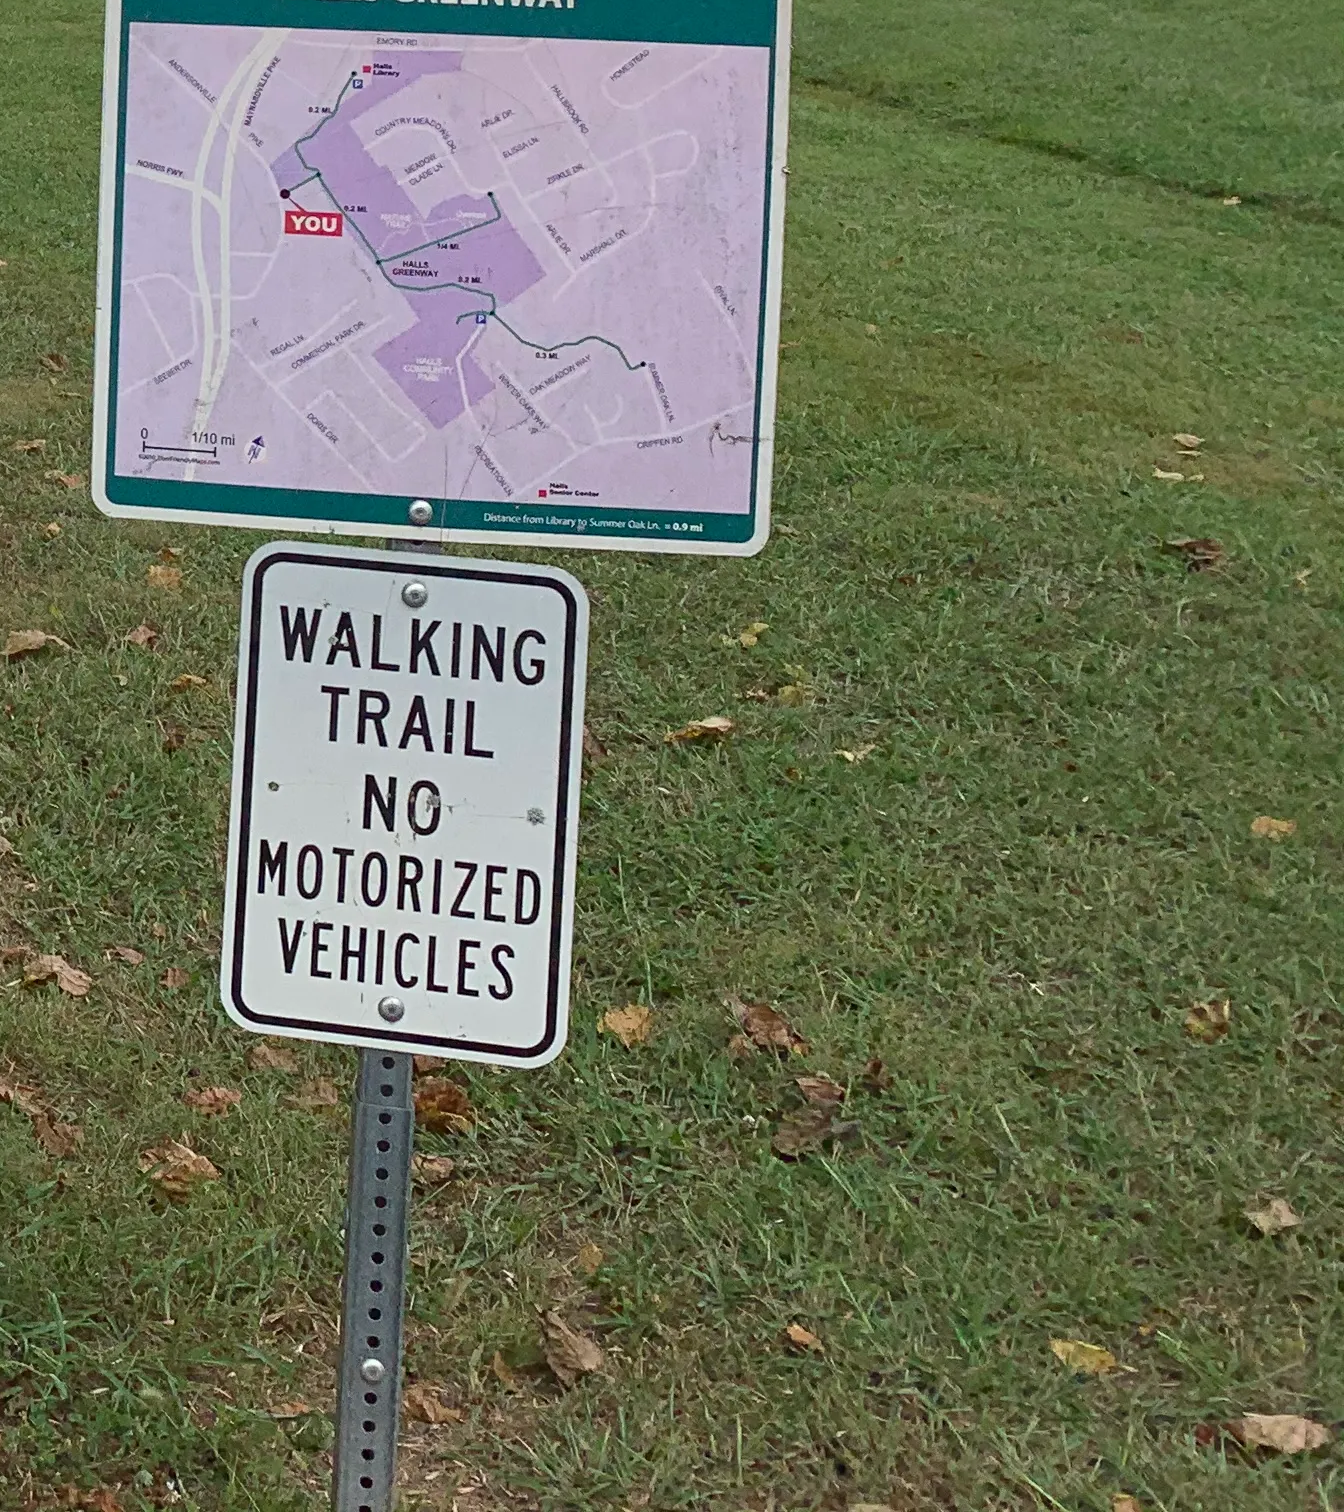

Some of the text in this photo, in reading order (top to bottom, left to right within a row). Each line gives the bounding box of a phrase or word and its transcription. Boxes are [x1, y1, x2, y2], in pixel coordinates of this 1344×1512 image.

[376, 37, 404, 46] EMORY
[610, 49, 650, 81] HOMESTEAD
[168, 59, 217, 104] ANDERSONVILLE
[244, 55, 281, 127] MAYNARDVILLE PIKE
[375, 117, 412, 136] COUNTRY
[136, 159, 165, 173] NORRIS
[404, 153, 437, 175] MEADOW
[290, 215, 337, 232] YOU
[402, 261, 429, 269] HALLS
[580, 238, 616, 262] MARSHALL
[392, 268, 439, 278] GREENWAY
[269, 338, 297, 357] REGAL
[291, 338, 335, 370] COMMERCIAL
[333, 327, 354, 342] PARK
[529, 354, 592, 395] OAK MEADOW WAY
[498, 373, 550, 431] WINTER OAKS WAY
[140, 427, 236, 446] 0 1/10 mi
[474, 445, 506, 486] RECREATION
[483, 512, 522, 523] Distance
[523, 514, 544, 524] from
[545, 516, 576, 527] Library
[578, 519, 587, 527] to
[589, 518, 626, 529] Summer
[628, 520, 645, 529] Oak
[647, 521, 661, 530] Ln.
[672, 522, 688, 531] 0.9
[690, 523, 703, 532] mi
[280, 605, 547, 686] WALKING
[321, 685, 494, 759] TRAIL
[362, 774, 442, 836] NO
[257, 839, 540, 925] MOTORIZED
[277, 918, 515, 1001] VEHICLES
